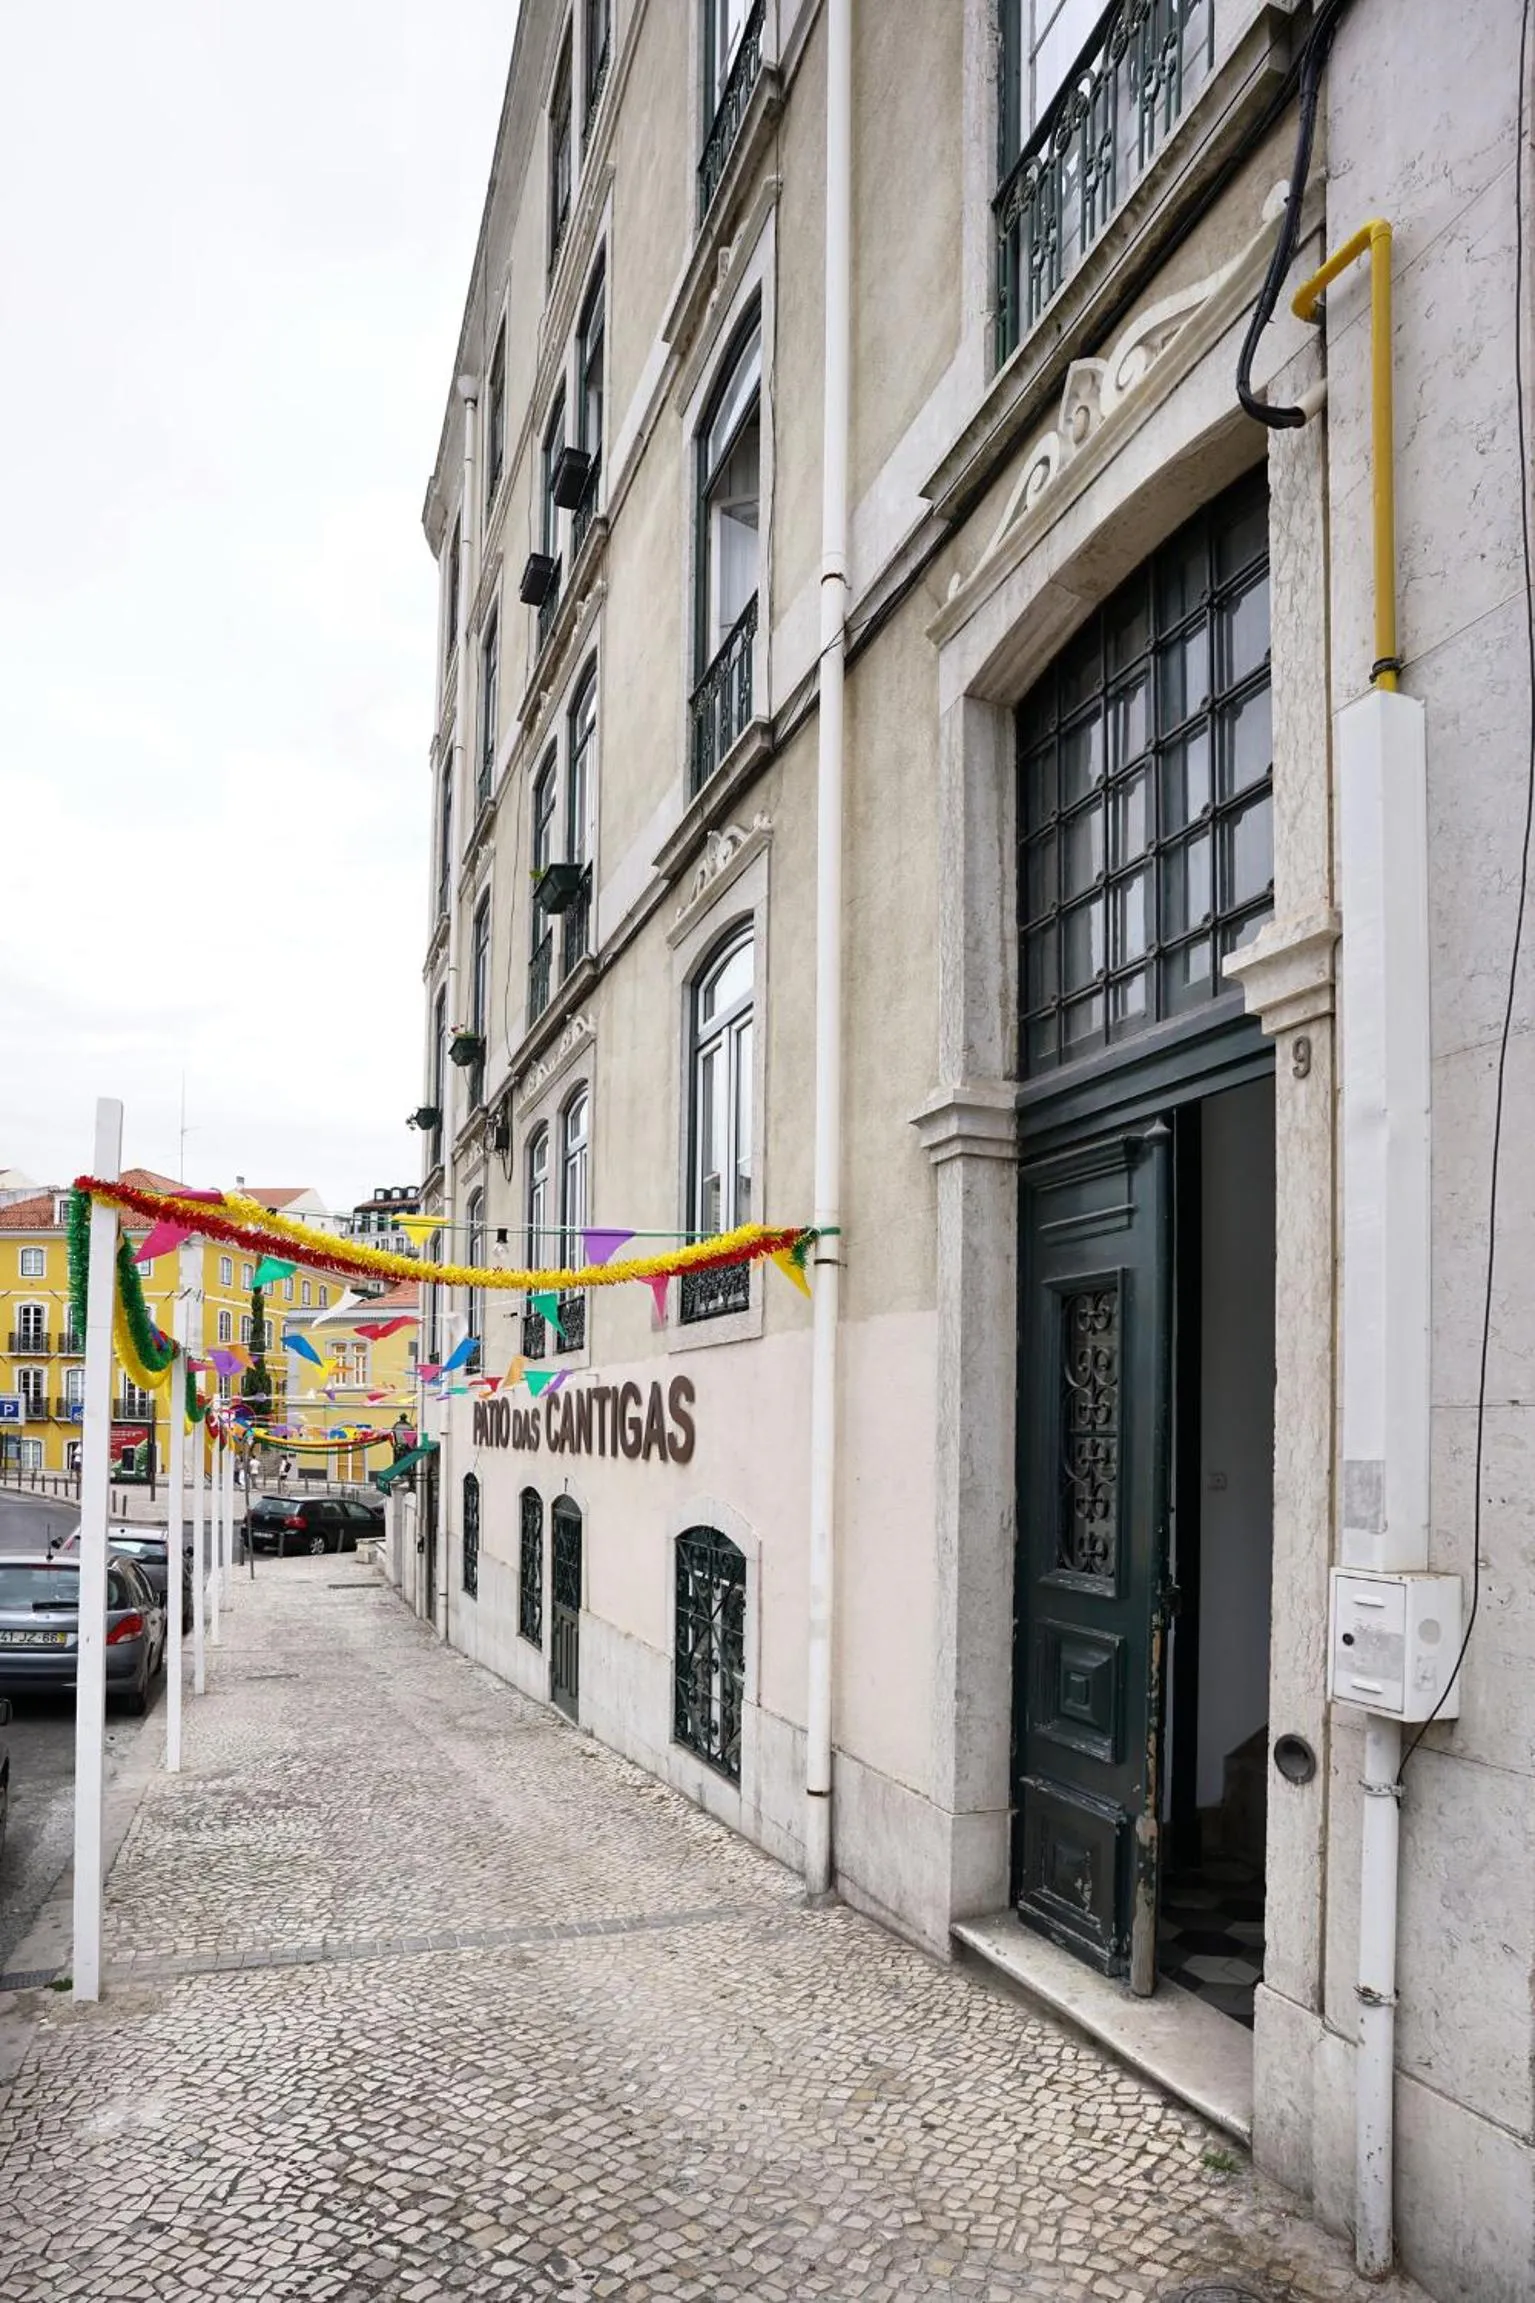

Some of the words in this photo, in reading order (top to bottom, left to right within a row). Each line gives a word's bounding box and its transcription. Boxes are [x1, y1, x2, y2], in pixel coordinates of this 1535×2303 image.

[1292, 1035, 1312, 1080] 9
[4, 1404, 14, 1417] P
[512, 1407, 541, 1453] DAS
[545, 1375, 696, 1465] CANTIGAS
